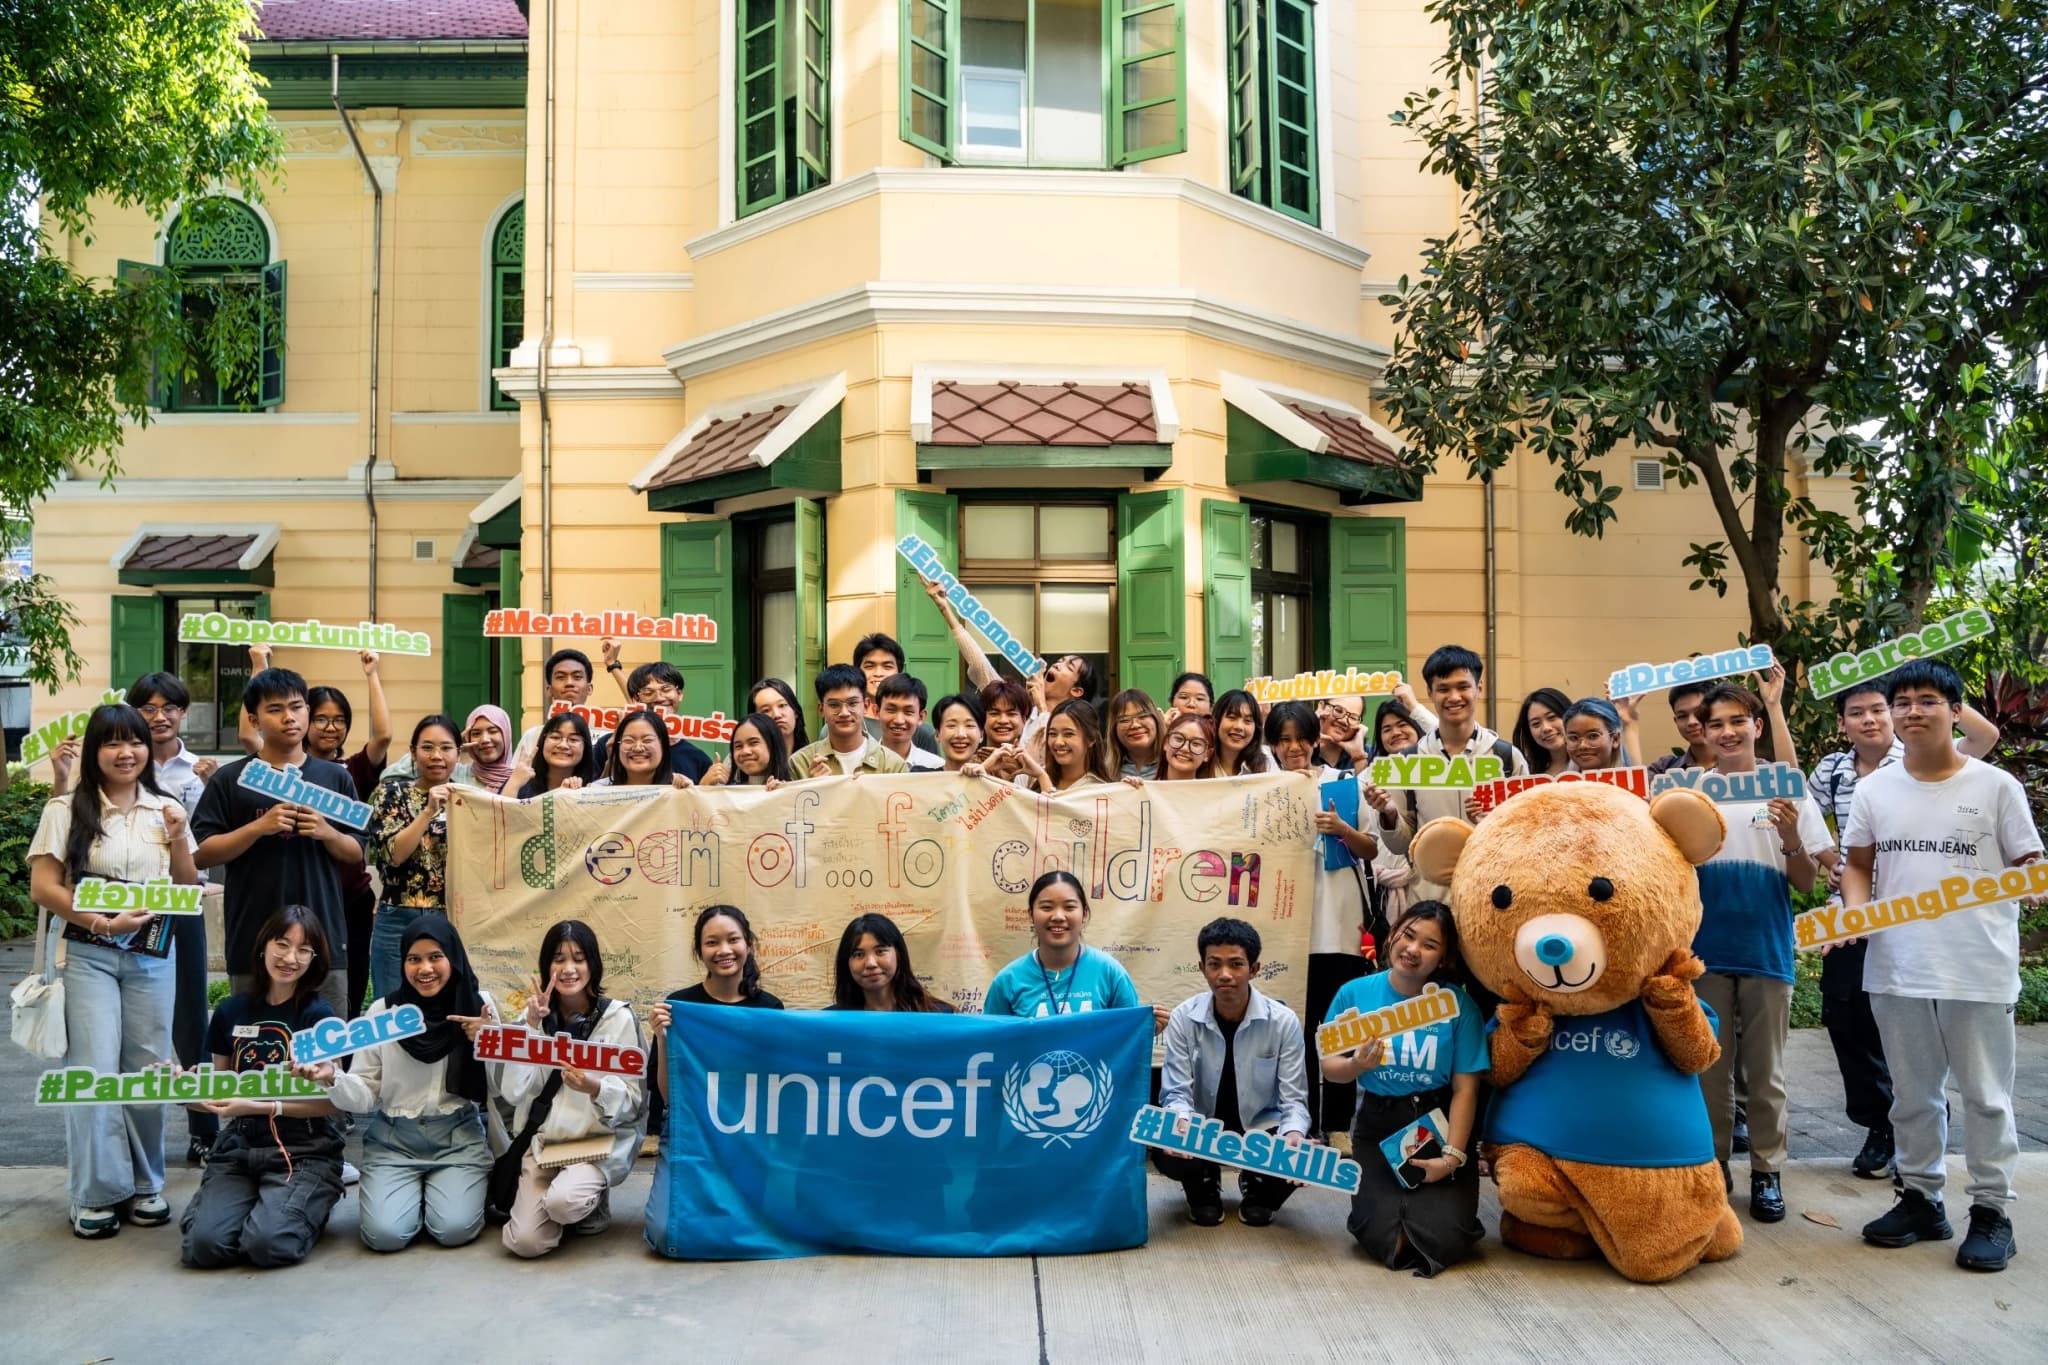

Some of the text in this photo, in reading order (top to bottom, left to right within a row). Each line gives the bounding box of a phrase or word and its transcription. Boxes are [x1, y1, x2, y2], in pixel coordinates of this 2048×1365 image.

[181, 613, 430, 653] #Opportunities
[485, 610, 716, 641] #MentalHealth
[1809, 608, 1990, 695] #Careers
[1244, 668, 1400, 699] #YouthVoices
[1610, 646, 1772, 696] #Dreams
[1371, 756, 1502, 787] #YPAB
[1654, 765, 1804, 800] #Youth
[241, 762, 370, 828] #เป้าหมาย
[1876, 840, 1978, 857] ALVIN KLEIN JEANS
[77, 878, 200, 912] #อาชีพ
[293, 1005, 422, 1063] #Care
[1319, 986, 1457, 1056] #มีงานทำ
[1550, 1026, 1602, 1053] icef
[476, 1028, 644, 1075] #Future
[39, 1063, 327, 1100] #Participatio
[1374, 1068, 1415, 1082] unicef
[706, 1051, 995, 1139] unicef
[1133, 1107, 1360, 1191] #LifeSkills
